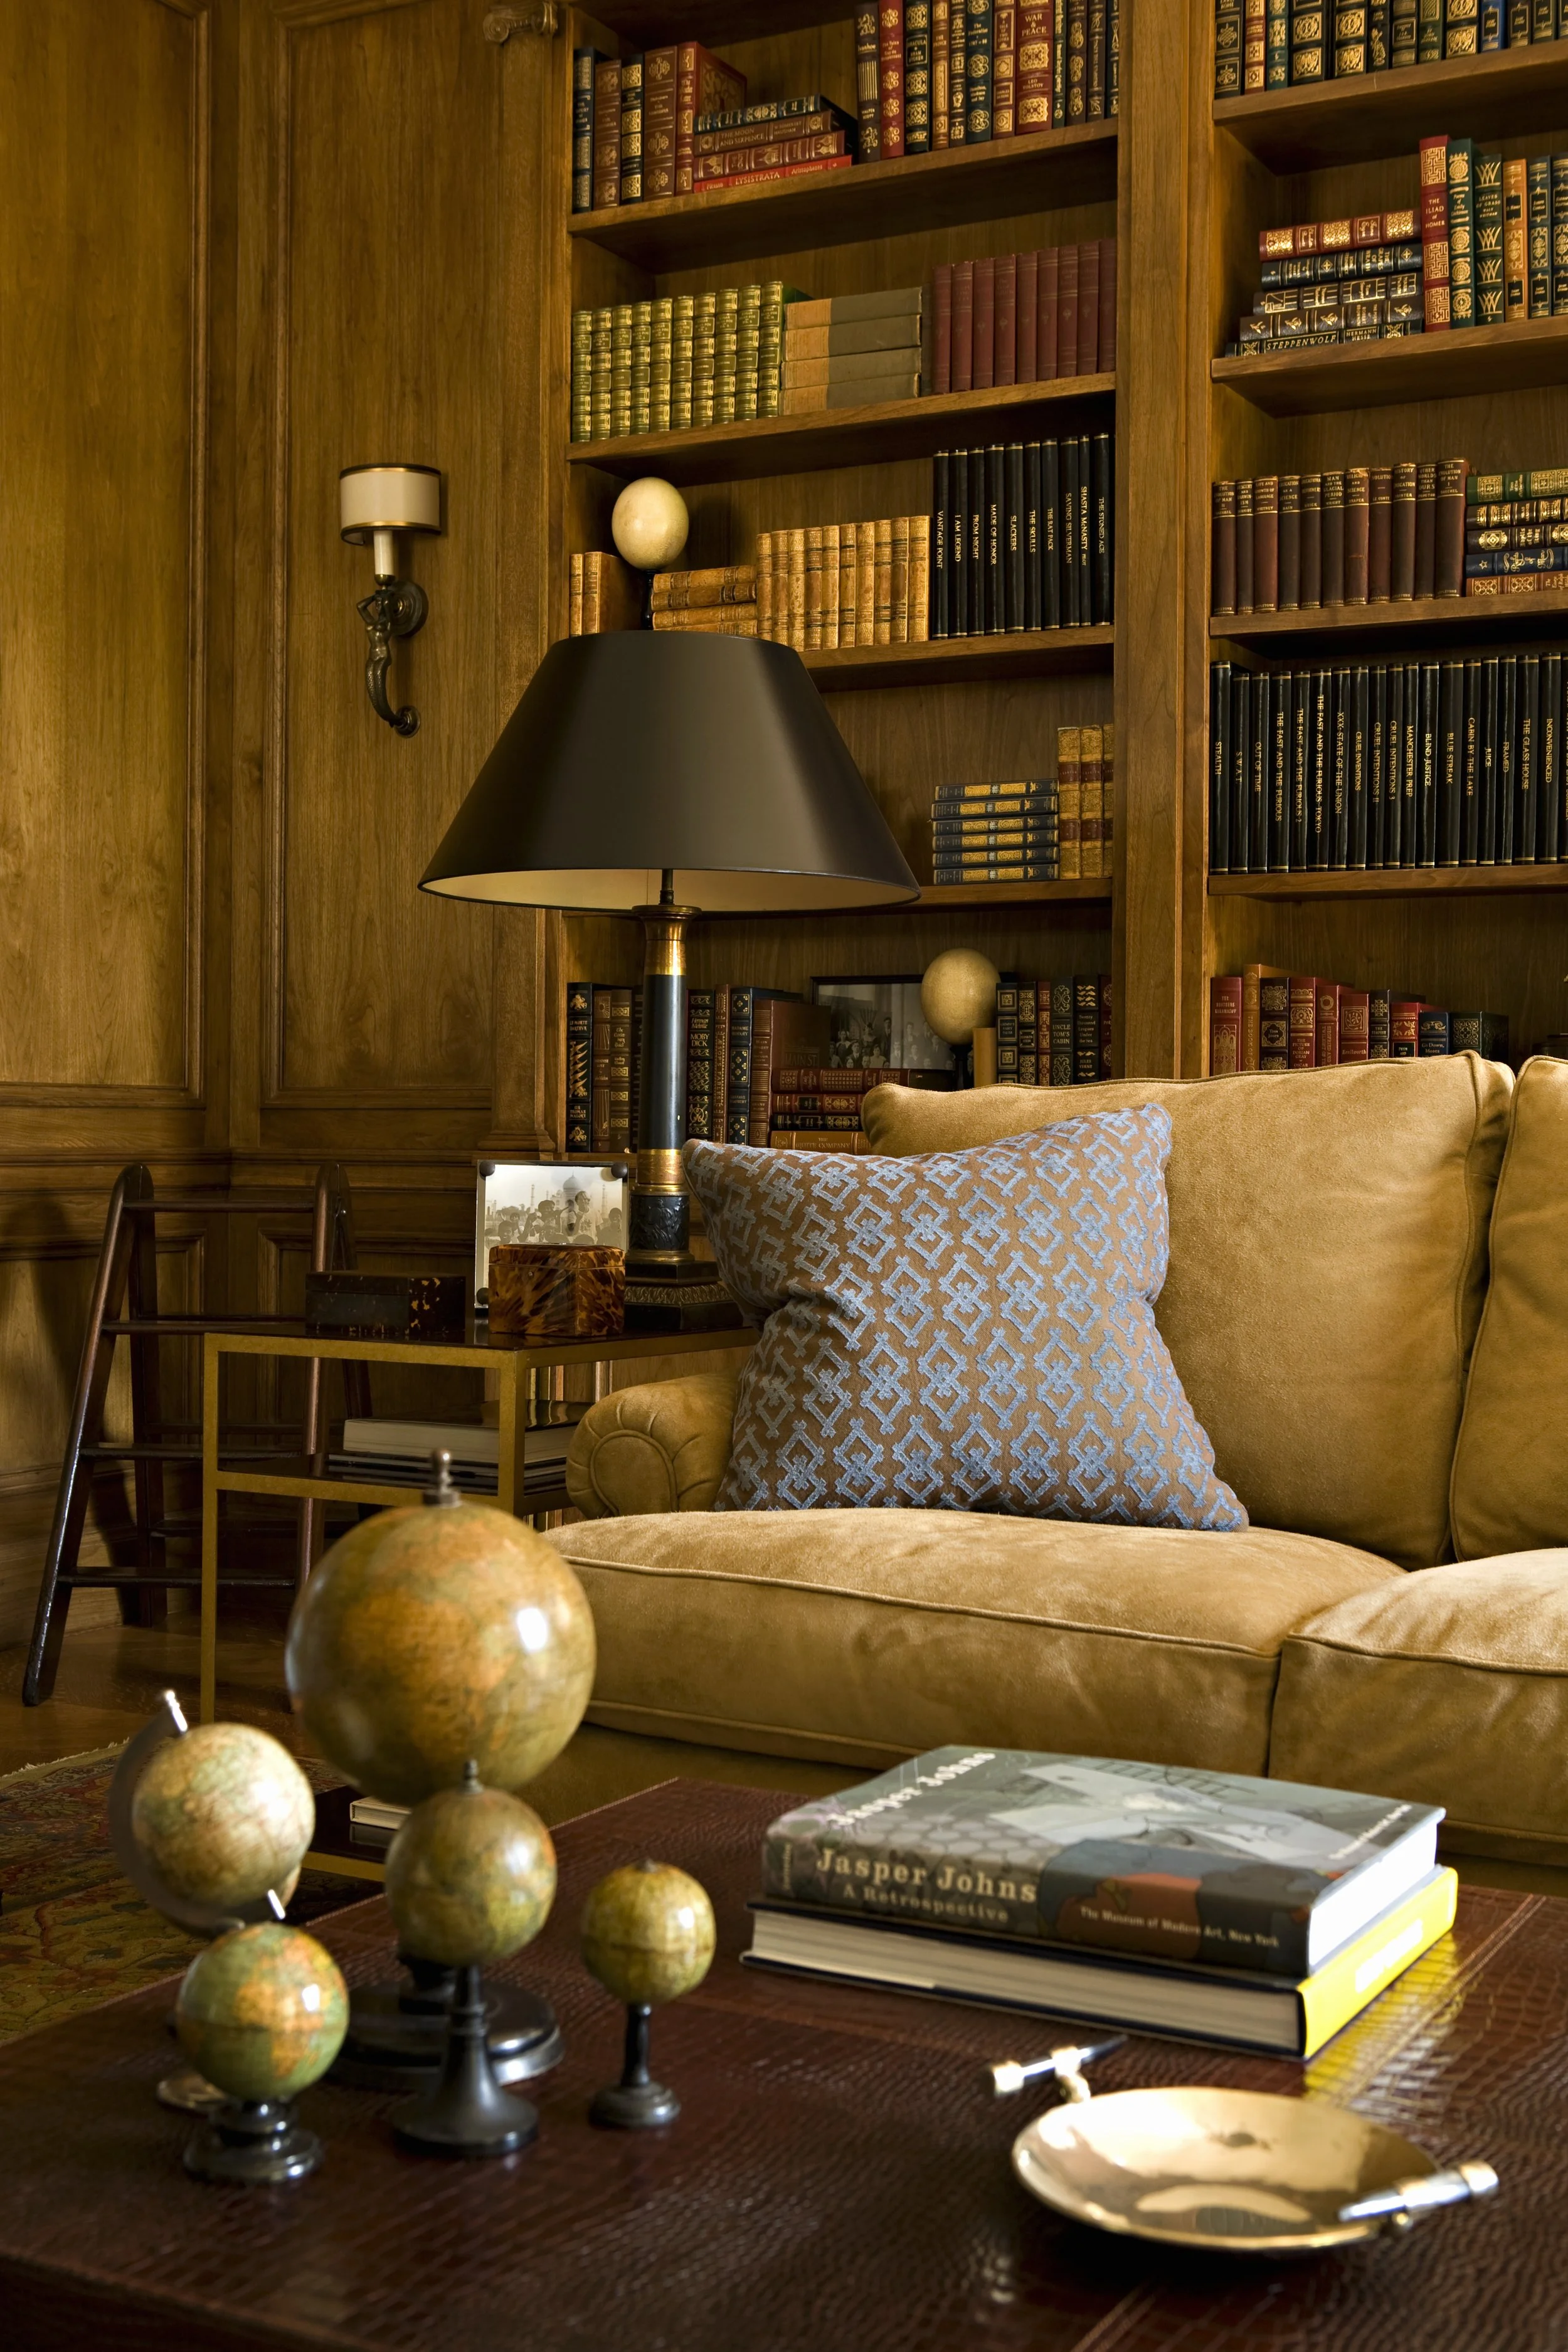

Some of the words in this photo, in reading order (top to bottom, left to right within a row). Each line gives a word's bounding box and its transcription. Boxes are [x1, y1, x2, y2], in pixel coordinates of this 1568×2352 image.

[1025, 13, 1042, 22] WAR
[1022, 26, 1047, 36] PEACE
[734, 128, 754, 136] MOON
[734, 134, 765, 144] SIXPENCE
[736, 172, 780, 185] LYSISTRATA
[792, 165, 823, 174] Aristophanes
[1426, 206, 1444, 215] ILIAD
[1426, 220, 1445, 228] HOMER
[1346, 328, 1377, 337] HERMANN
[1267, 335, 1337, 350] STEPPENWOLF
[955, 520, 961, 532] AM
[990, 527, 997, 537] OF
[1467, 744, 1475, 755] BY
[1255, 761, 1261, 771] OF
[1336, 758, 1343, 768] OF
[815, 1848, 928, 1887] Jasper
[936, 1865, 1039, 1903] Johns
[844, 1884, 855, 1899] A
[862, 1886, 1009, 1923] Retrospective
[1079, 1907, 1099, 1922] The
[1101, 1909, 1145, 1928] Museum
[1148, 1916, 1159, 1929] of
[1160, 1918, 1202, 1936] Modern
[1204, 1927, 1226, 1941] Art,
[1228, 1930, 1253, 1945] New
[1254, 1932, 1279, 1947] York
